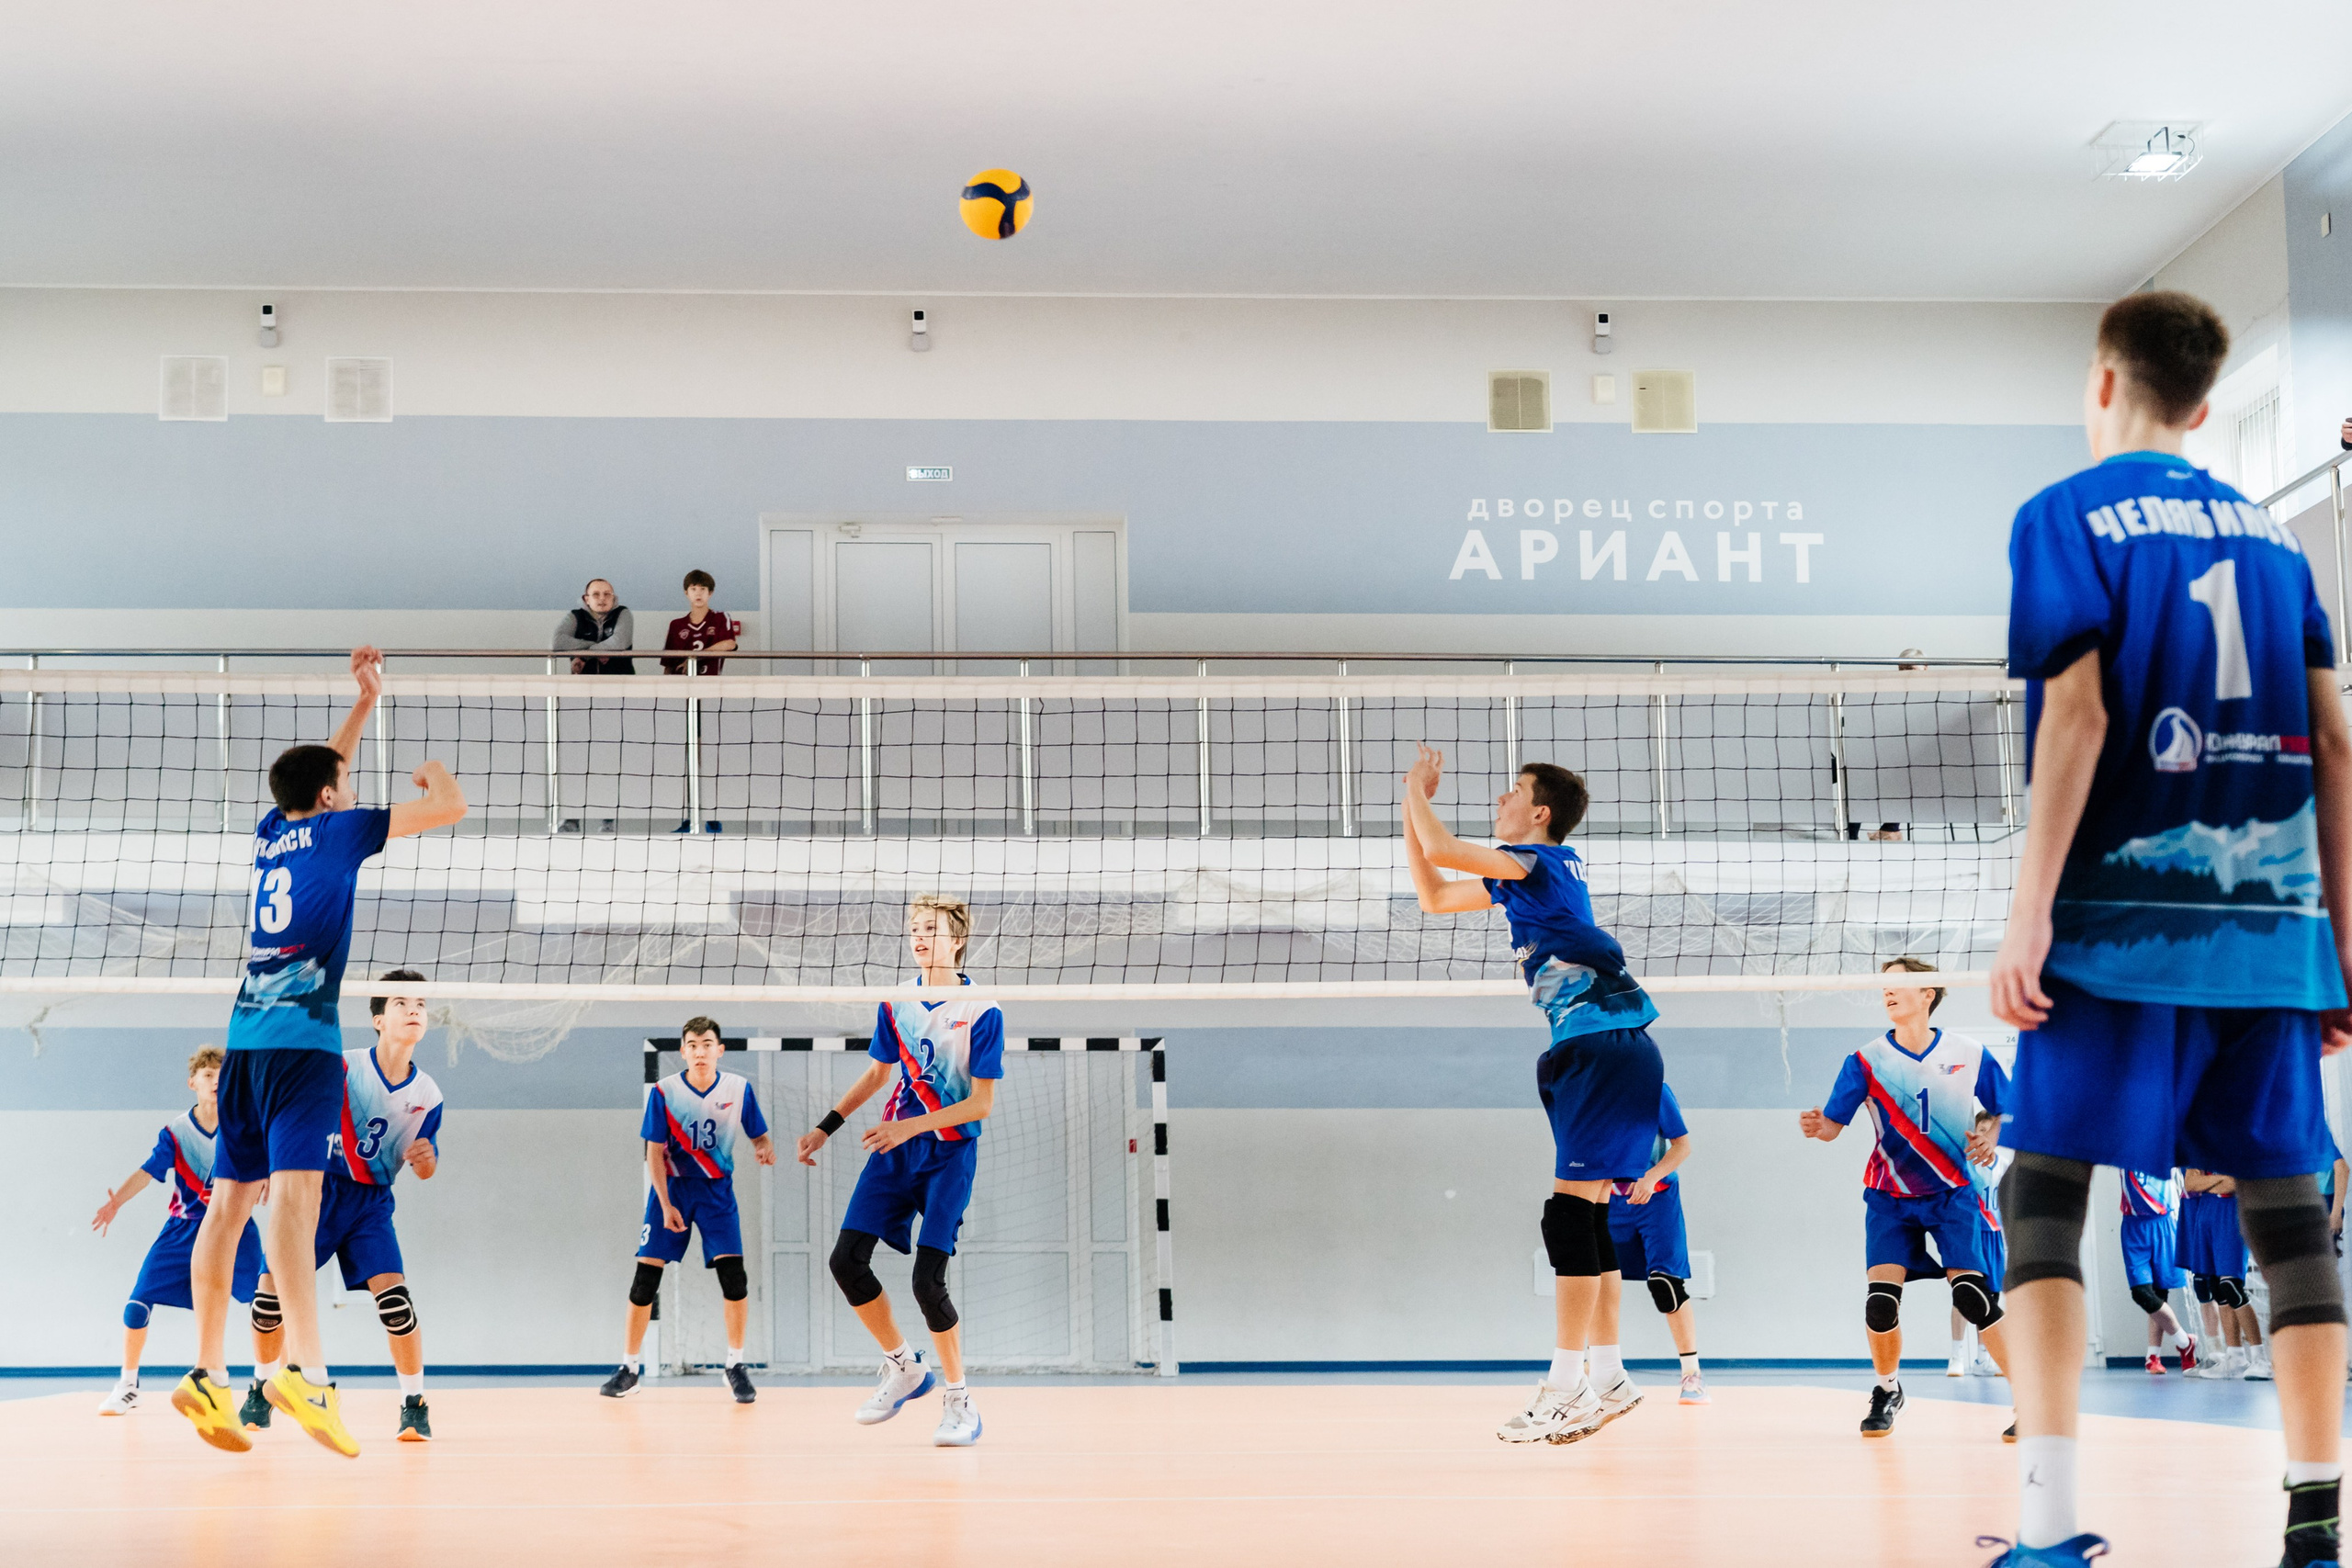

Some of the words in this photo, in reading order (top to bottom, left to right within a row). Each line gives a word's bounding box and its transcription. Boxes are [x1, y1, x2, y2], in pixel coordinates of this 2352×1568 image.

[1467, 498, 1632, 525] дворец
[1648, 499, 1804, 526] спорта
[1449, 529, 1825, 583] АРИАНТ
[2188, 558, 2253, 701] 1
[250, 866, 293, 934] 13
[915, 1037, 937, 1084] 2
[1916, 1088, 1929, 1134] 1
[356, 1116, 389, 1160] 3
[689, 1118, 718, 1151] 13
